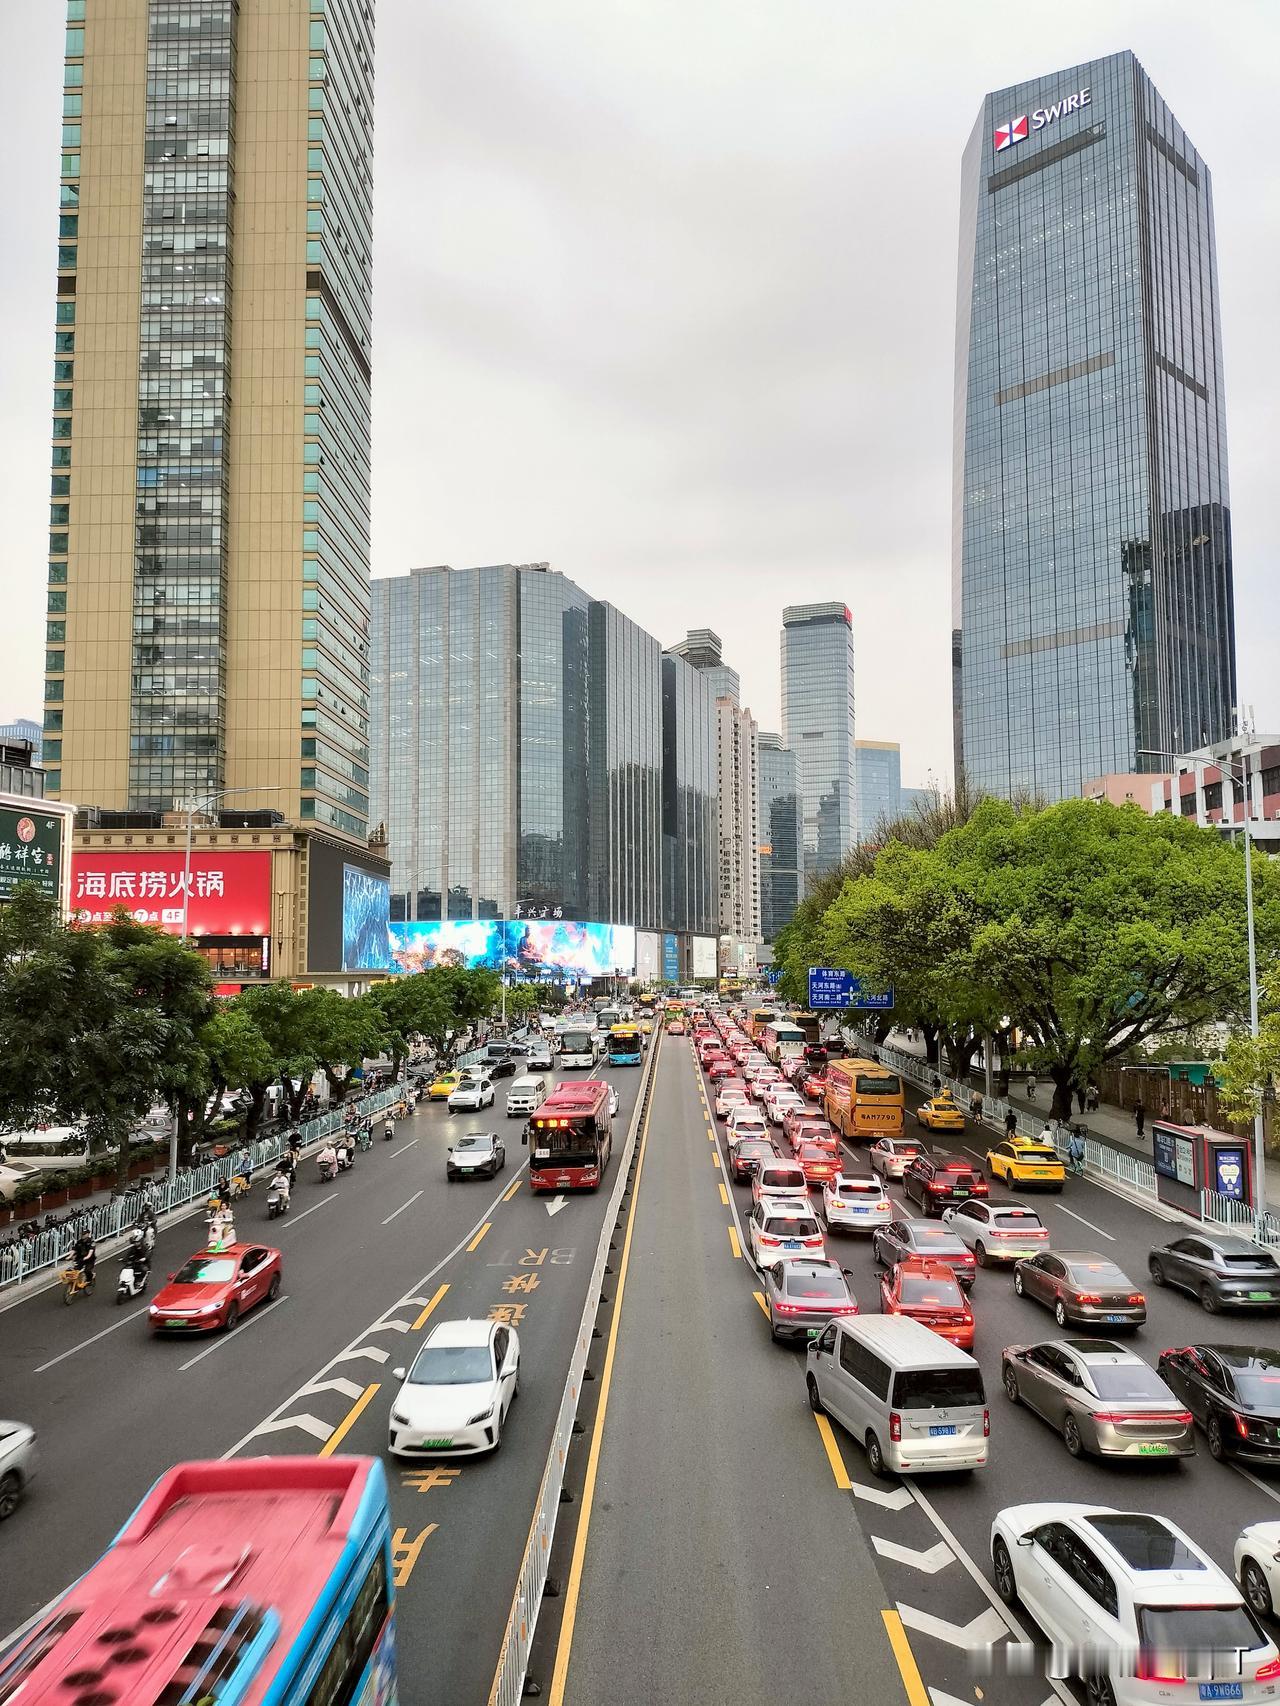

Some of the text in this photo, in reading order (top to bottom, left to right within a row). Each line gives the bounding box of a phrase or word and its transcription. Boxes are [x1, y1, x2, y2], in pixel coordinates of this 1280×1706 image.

[1031, 87, 1092, 131] SWIRE
[76, 870, 225, 899] 海底捞火锅
[486, 1247, 576, 1267] BRT
